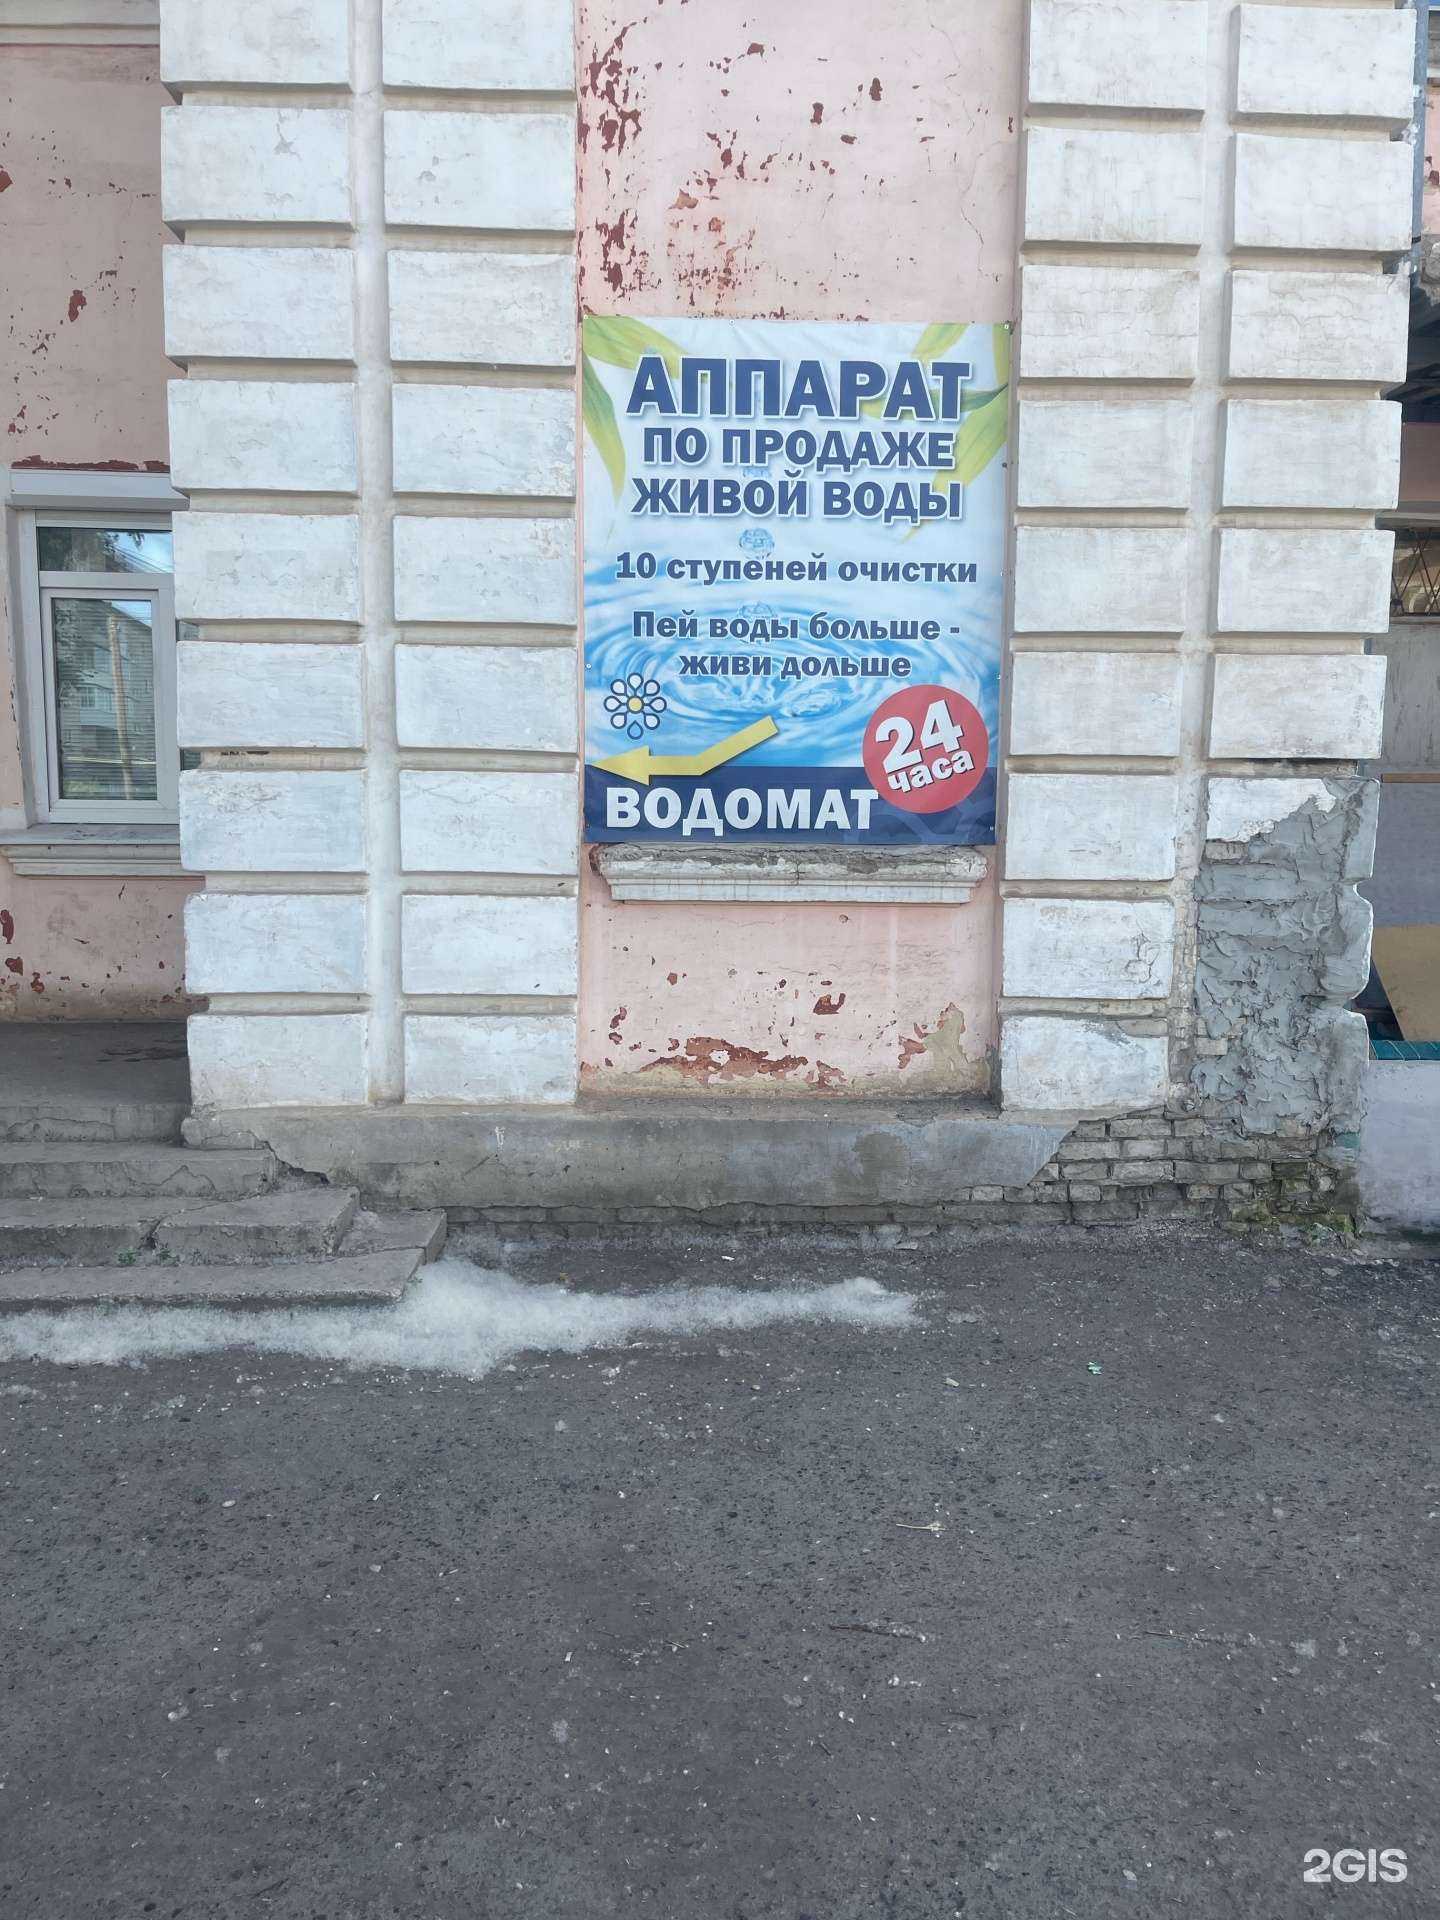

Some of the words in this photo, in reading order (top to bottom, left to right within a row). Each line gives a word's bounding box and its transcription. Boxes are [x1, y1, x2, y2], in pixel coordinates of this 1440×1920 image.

[626, 356, 971, 420] АППАРАТ
[643, 427, 707, 464] ПО
[722, 428, 955, 473] ПРОДАЖЕ
[631, 469, 807, 516] ЖИВОЙ
[823, 481, 961, 524] ВОДЫ
[616, 552, 656, 580] 10
[666, 552, 827, 586] ступеней
[837, 561, 977, 583] очистки
[633, 609, 698, 639] Пей
[709, 618, 798, 643] воды
[809, 611, 940, 641] больше
[678, 654, 771, 677] живи
[780, 656, 911, 679] дольше
[874, 699, 965, 775] 24
[886, 748, 976, 794] часа
[606, 787, 879, 837] ВОДОМАТ
